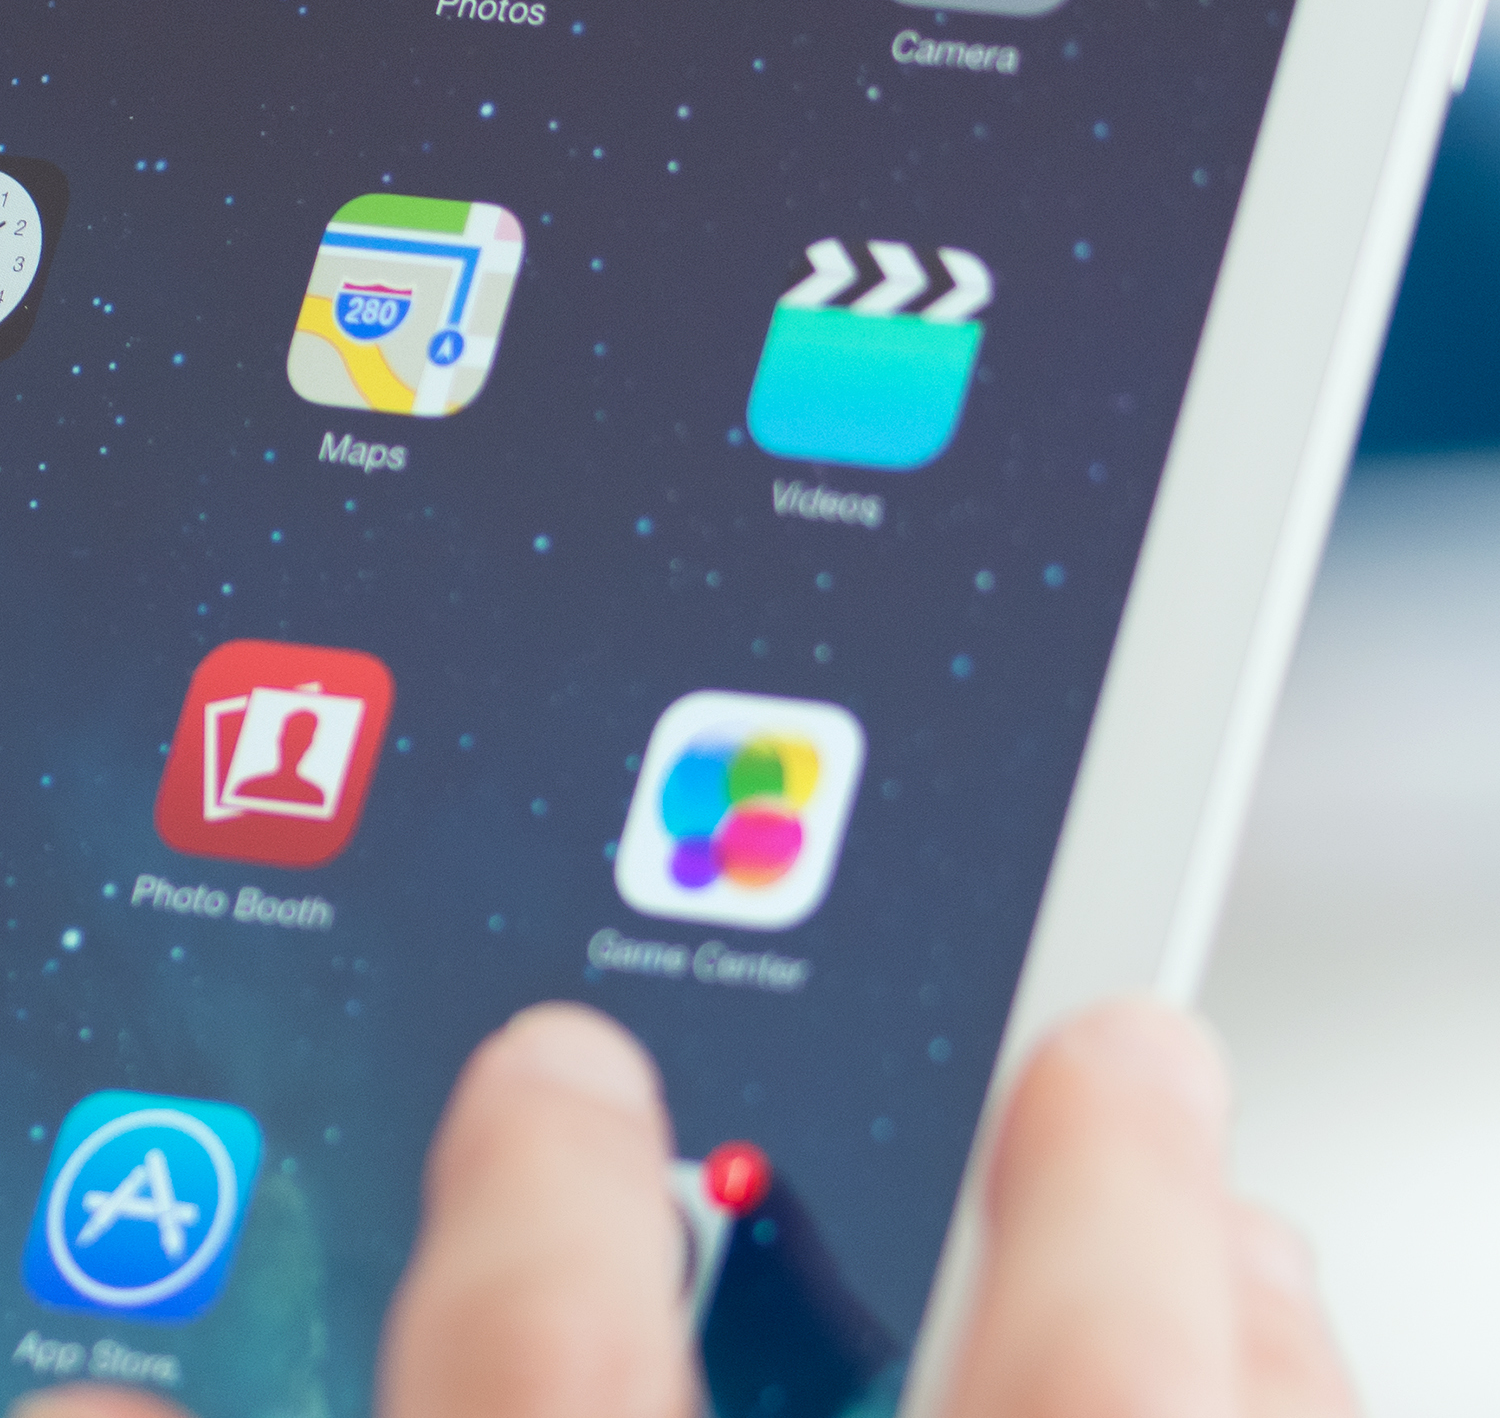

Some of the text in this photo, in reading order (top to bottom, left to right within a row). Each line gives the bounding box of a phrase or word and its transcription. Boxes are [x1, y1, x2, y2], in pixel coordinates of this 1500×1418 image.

[890, 29, 1021, 75] Camera
[1, 191, 10, 208] 1
[14, 219, 28, 237] 2
[12, 255, 26, 273] 3
[343, 295, 399, 327] 280
[318, 431, 407, 473] Maps
[772, 480, 883, 528] Videos
[130, 874, 334, 928] Photo Booth
[12, 1330, 86, 1378] App
